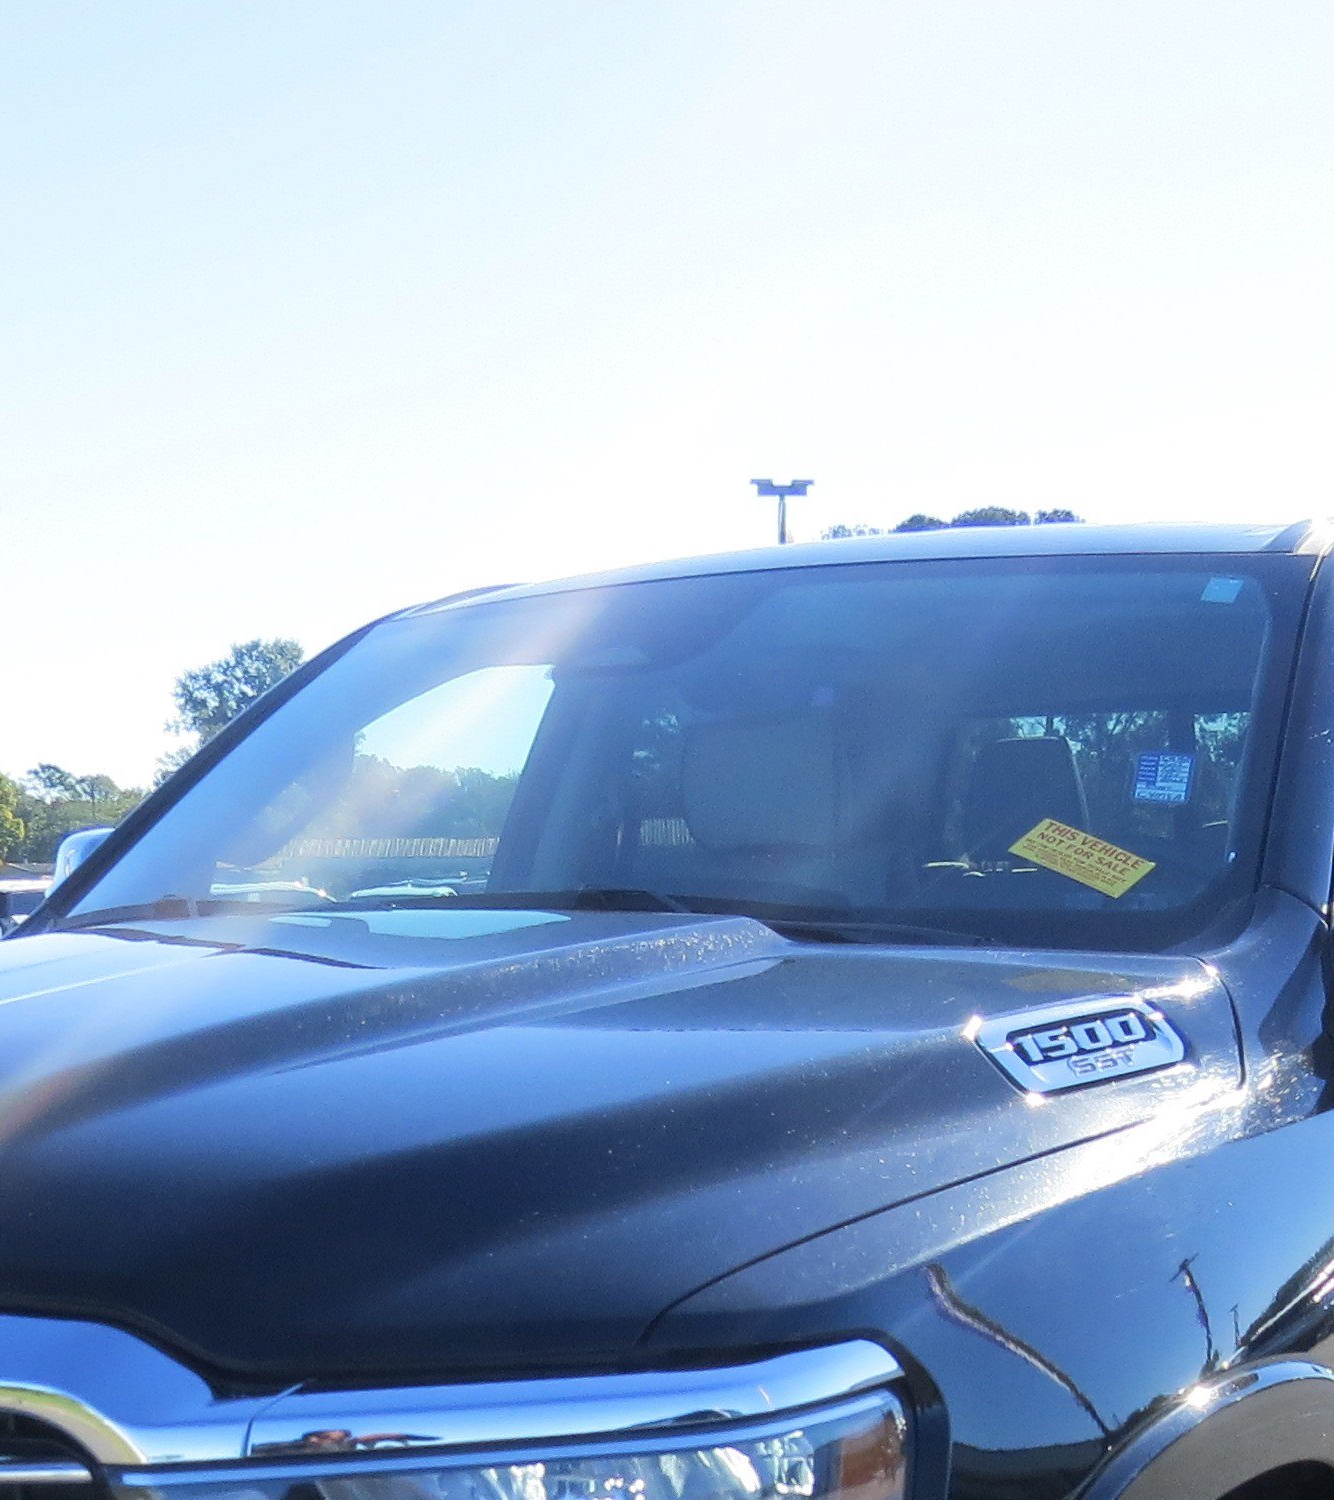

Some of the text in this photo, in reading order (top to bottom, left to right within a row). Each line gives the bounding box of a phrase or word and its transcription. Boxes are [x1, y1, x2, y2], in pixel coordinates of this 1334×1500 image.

[1037, 831, 1132, 876] NOT FOR SALE
[1044, 821, 1080, 841] THIS
[1081, 835, 1145, 870] VEHICLE
[1015, 1013, 1146, 1061] 1500
